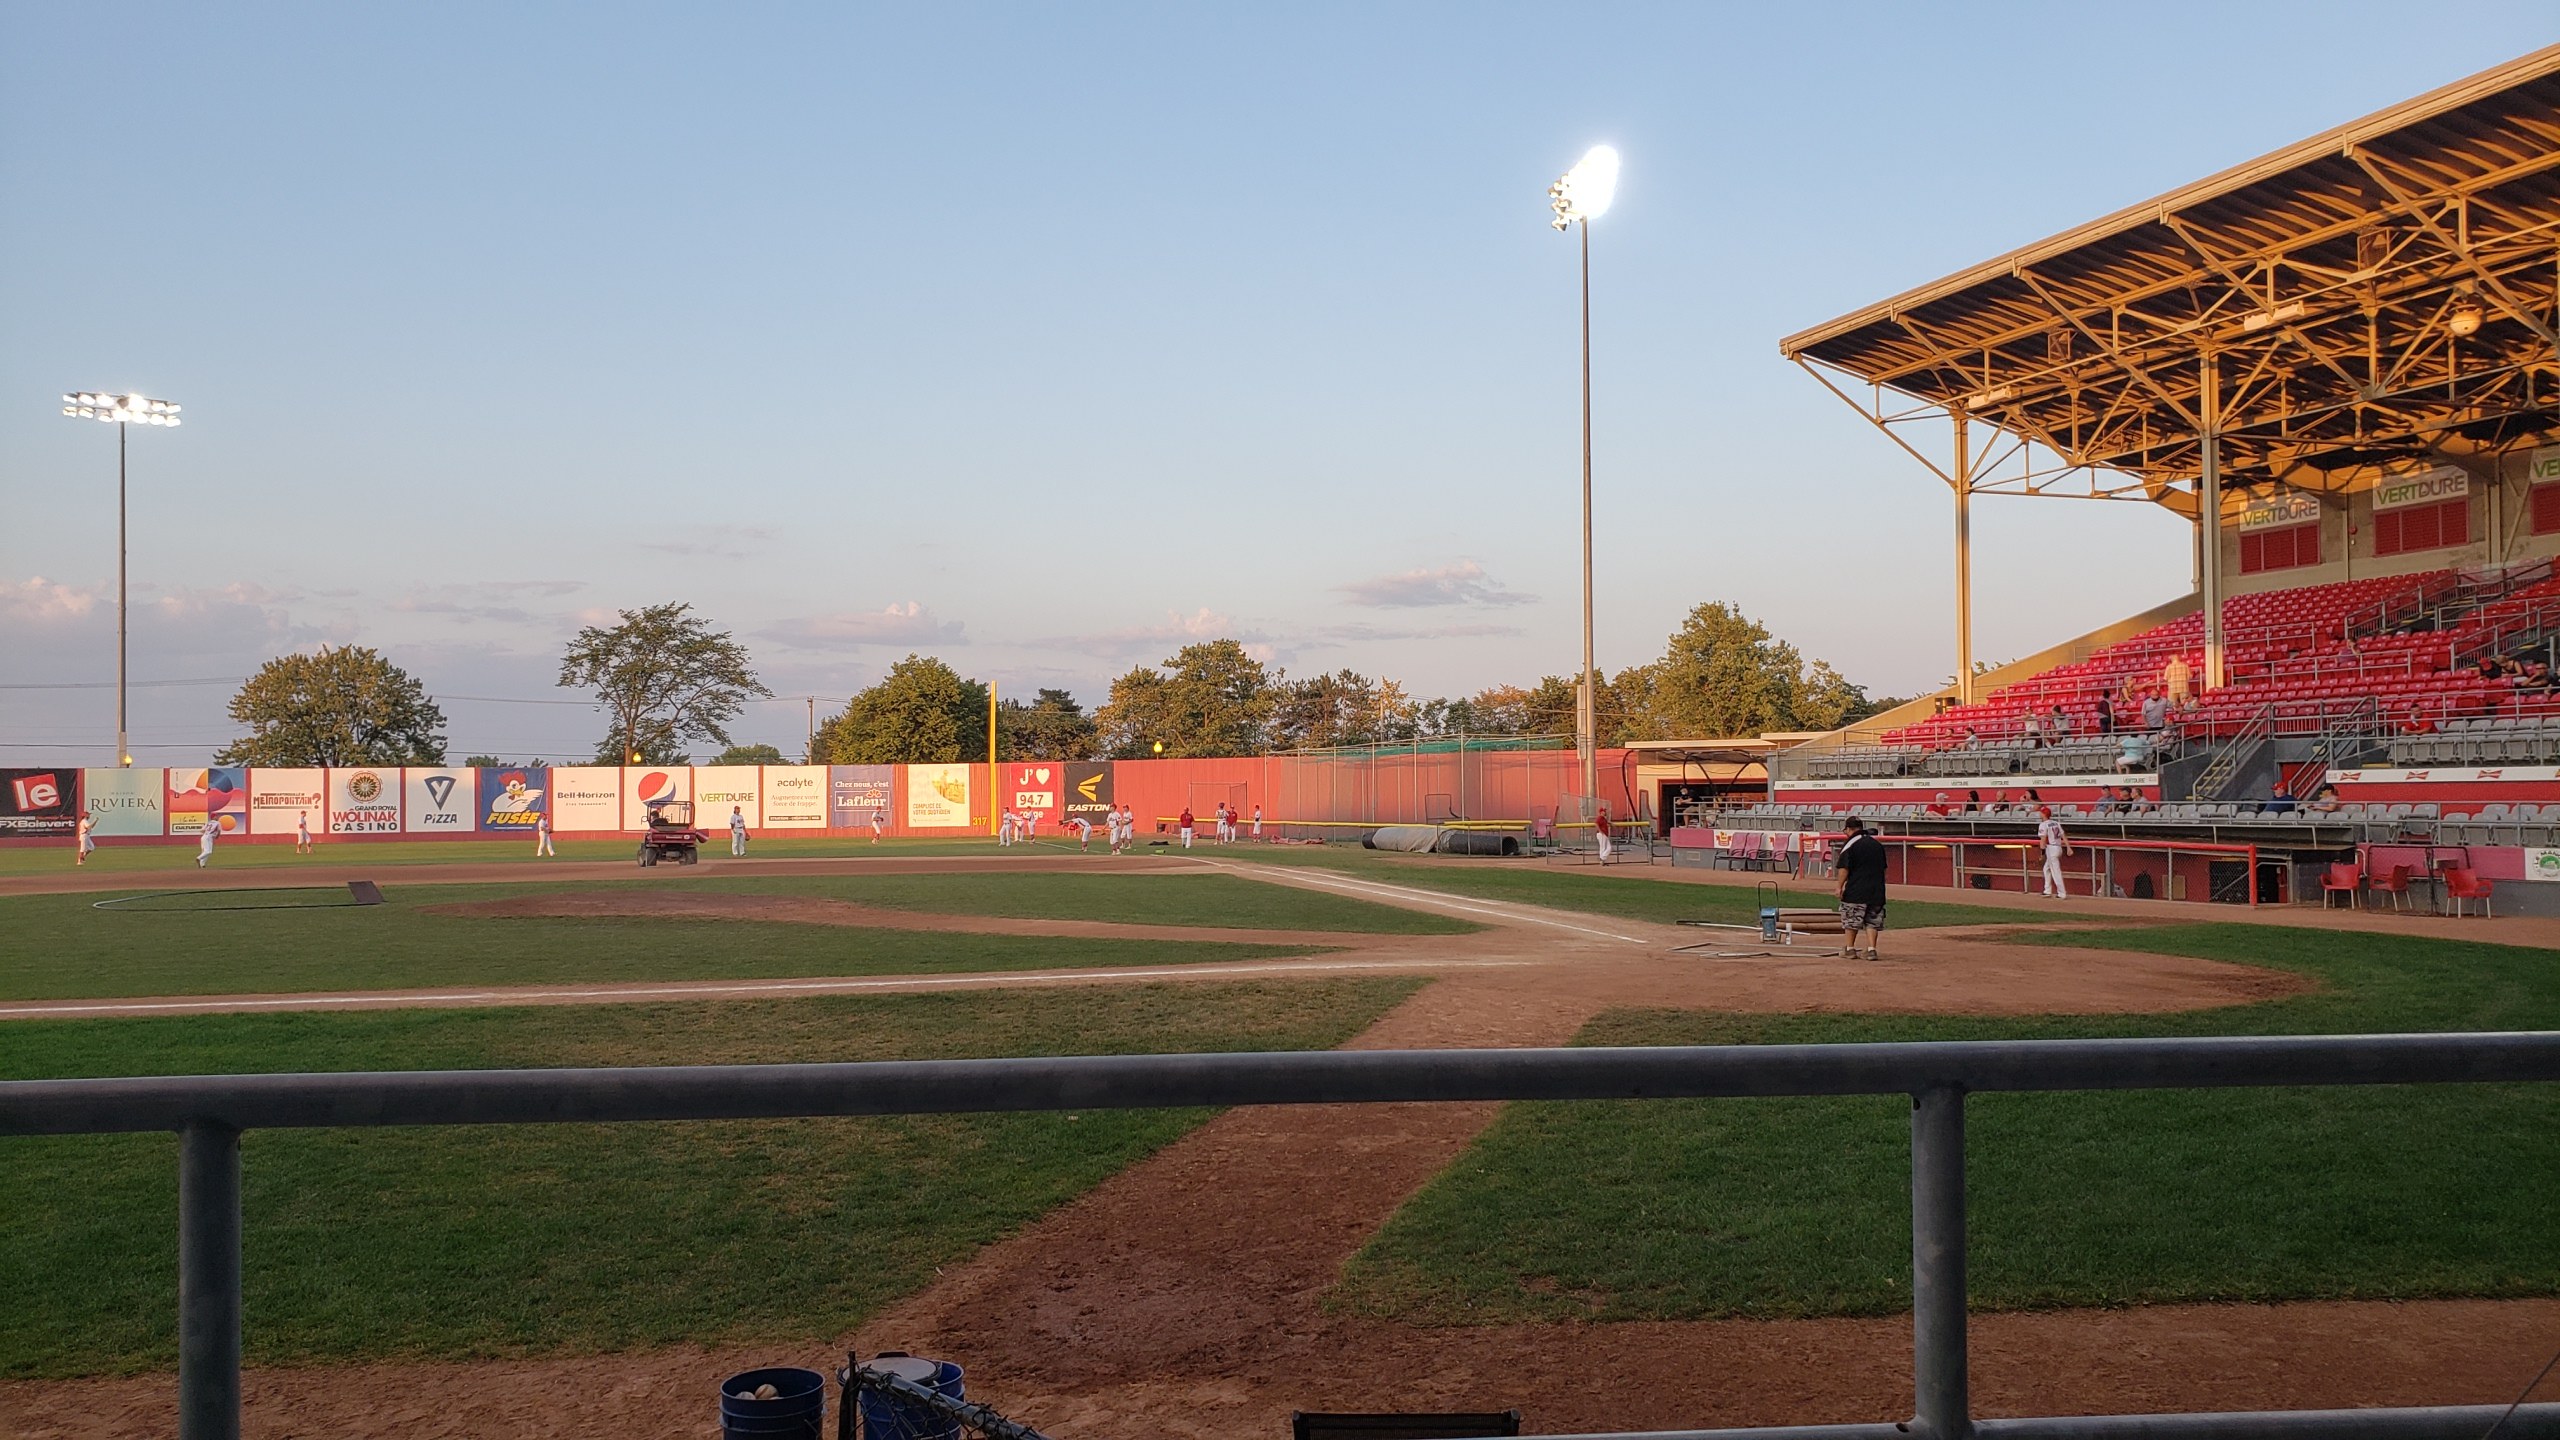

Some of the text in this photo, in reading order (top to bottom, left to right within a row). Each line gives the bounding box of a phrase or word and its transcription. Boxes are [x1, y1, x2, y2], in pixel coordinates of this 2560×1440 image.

[2376, 475, 2467, 504] VERTDURE
[2242, 501, 2318, 526] VERTDURE
[777, 777, 813, 789] acolyte
[699, 792, 754, 802] VERTDURE
[837, 796, 887, 807] Lafleur
[1020, 794, 1044, 805] 94.7
[91, 798, 157, 812] RIVIERA
[1067, 804, 1111, 812] EASTON
[332, 808, 397, 822] WÔLINAK
[486, 810, 540, 825] FUSÉE
[640, 813, 673, 825] psi
[1020, 811, 1044, 820] roge
[332, 822, 398, 832] CASINO
[973, 817, 987, 826] 317
